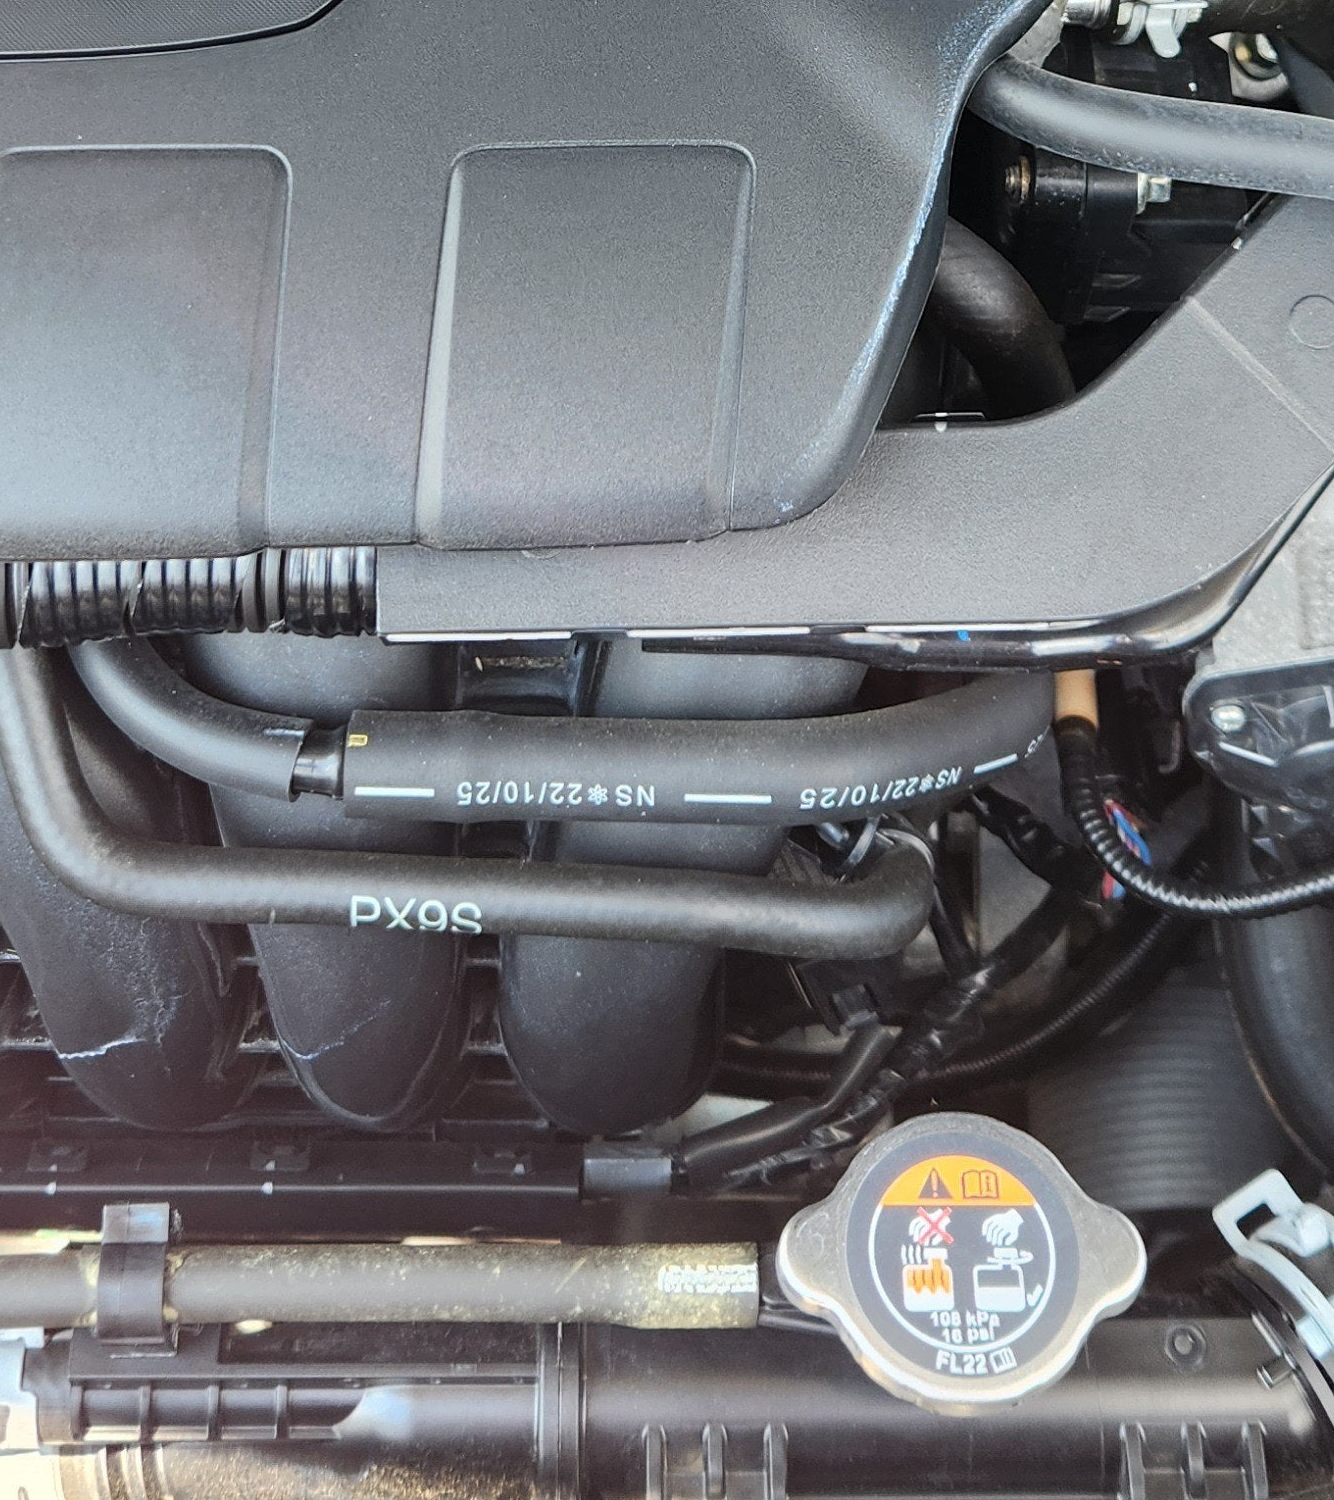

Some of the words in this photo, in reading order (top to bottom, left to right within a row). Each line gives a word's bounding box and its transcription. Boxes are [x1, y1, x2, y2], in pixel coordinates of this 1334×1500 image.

[349, 894, 483, 935] PX9S
[930, 1310, 962, 1328] 108
[965, 1309, 1001, 1328] kPa
[935, 1349, 989, 1375] FL22
